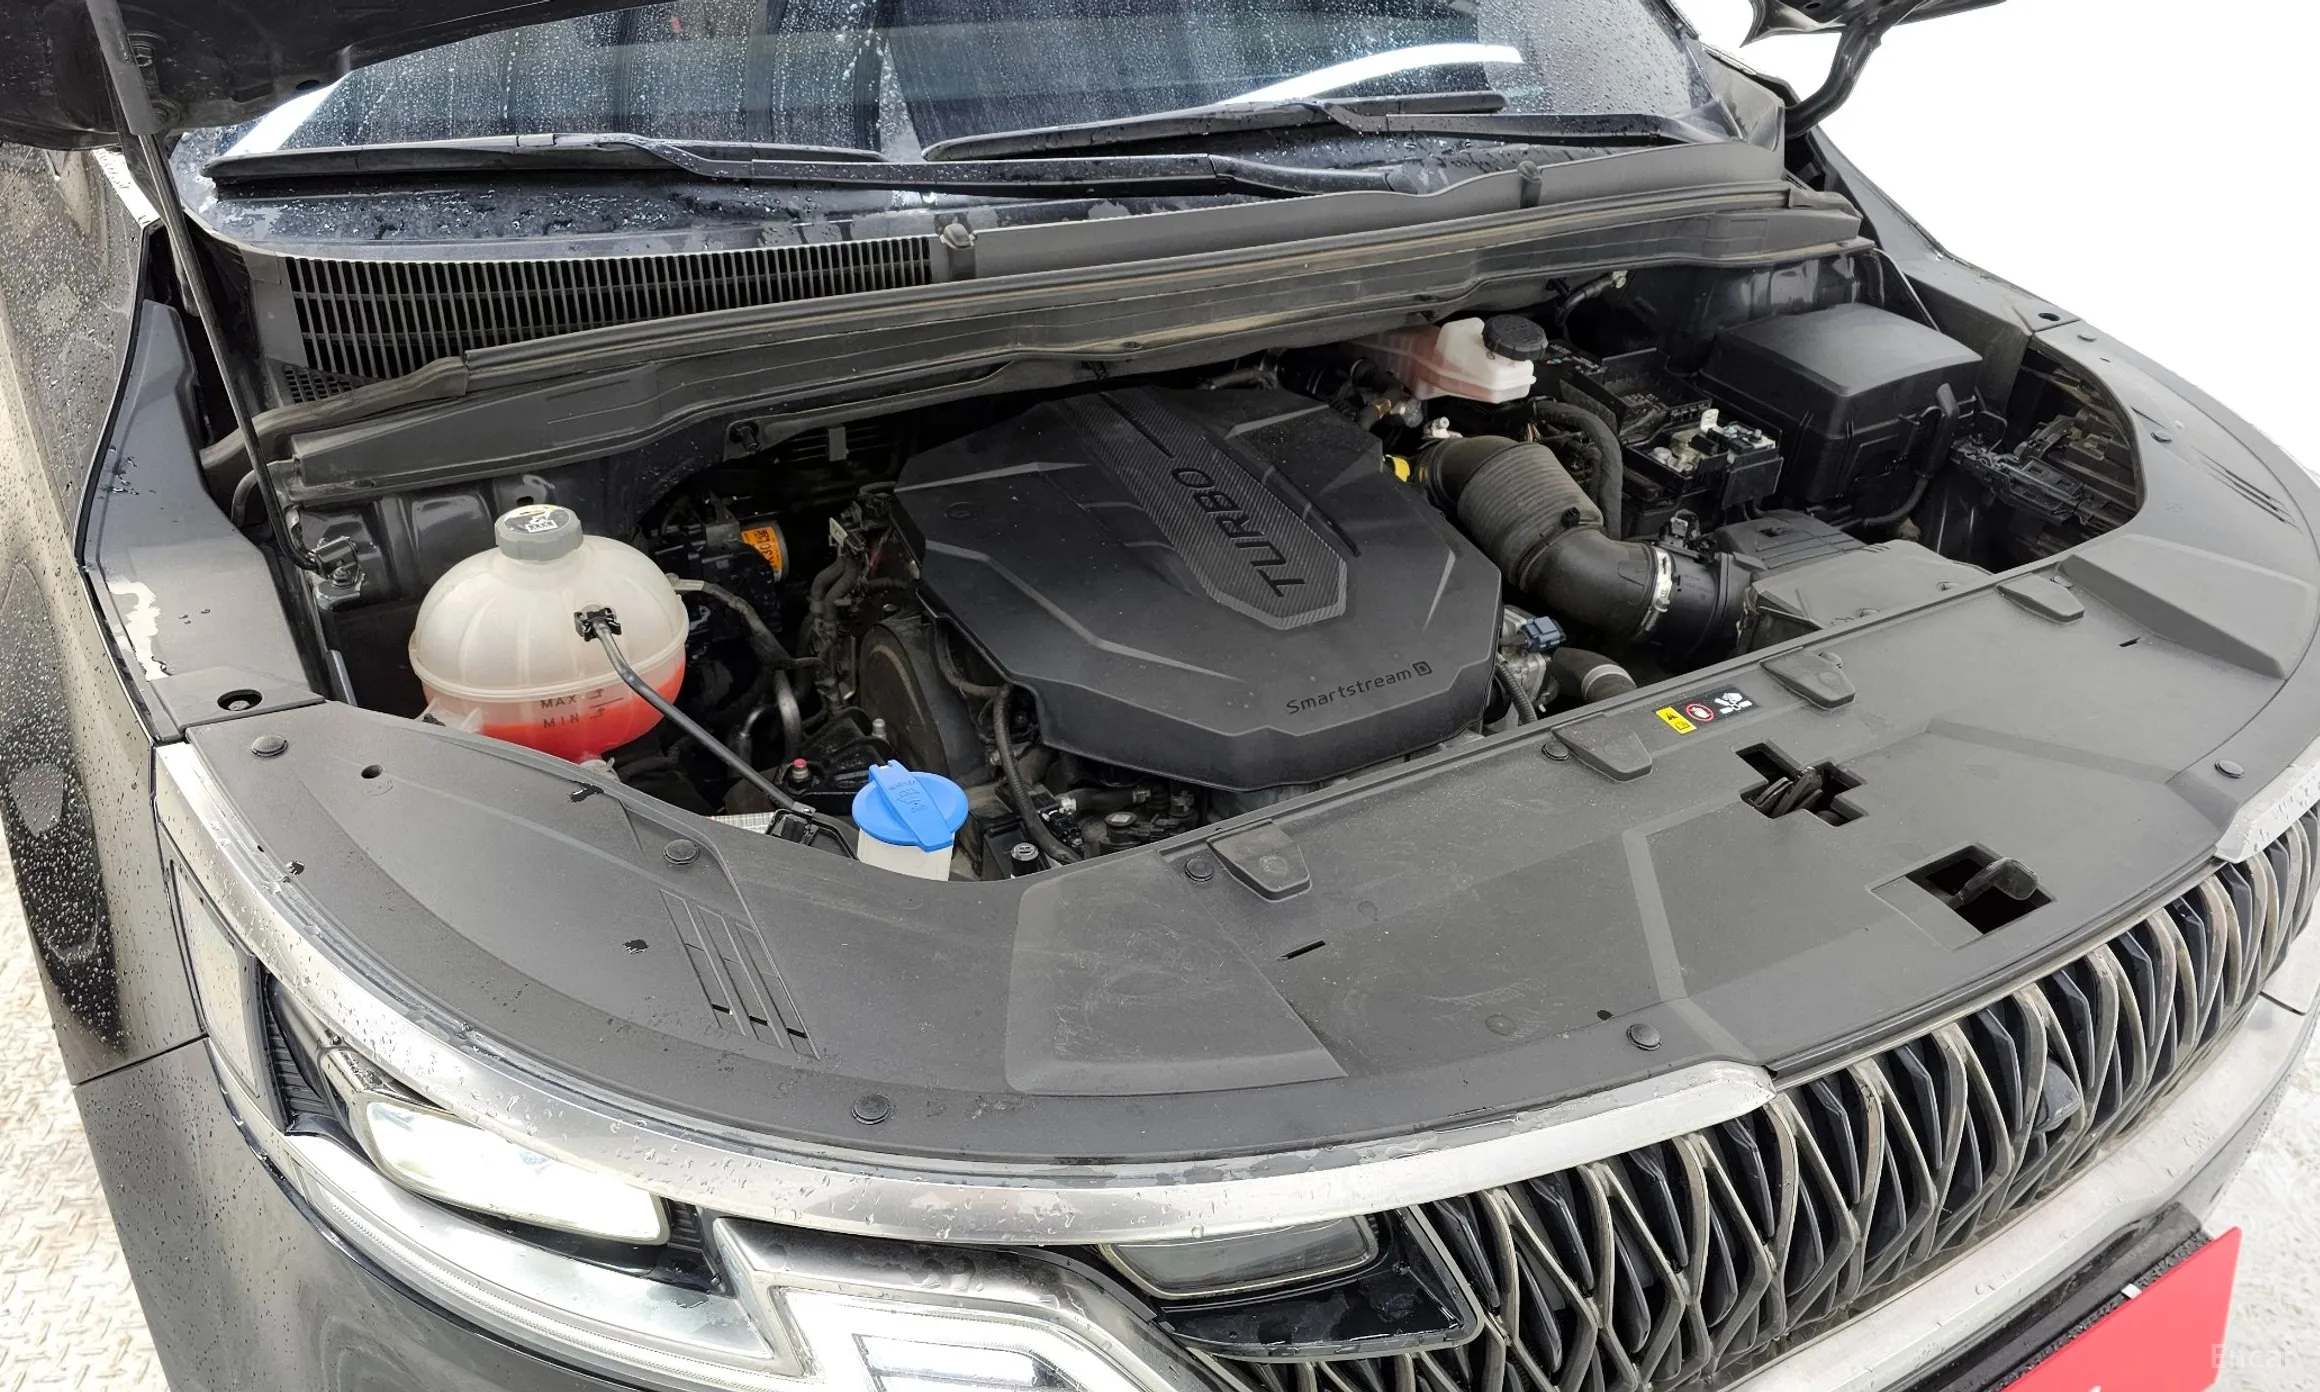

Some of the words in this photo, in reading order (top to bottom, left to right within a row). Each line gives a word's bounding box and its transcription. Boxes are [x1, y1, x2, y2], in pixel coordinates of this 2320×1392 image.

[1171, 467, 1306, 597] TURBO
[540, 694, 577, 709] MAX
[1286, 669, 1412, 715] Smartstream
[543, 713, 580, 729] MIN
